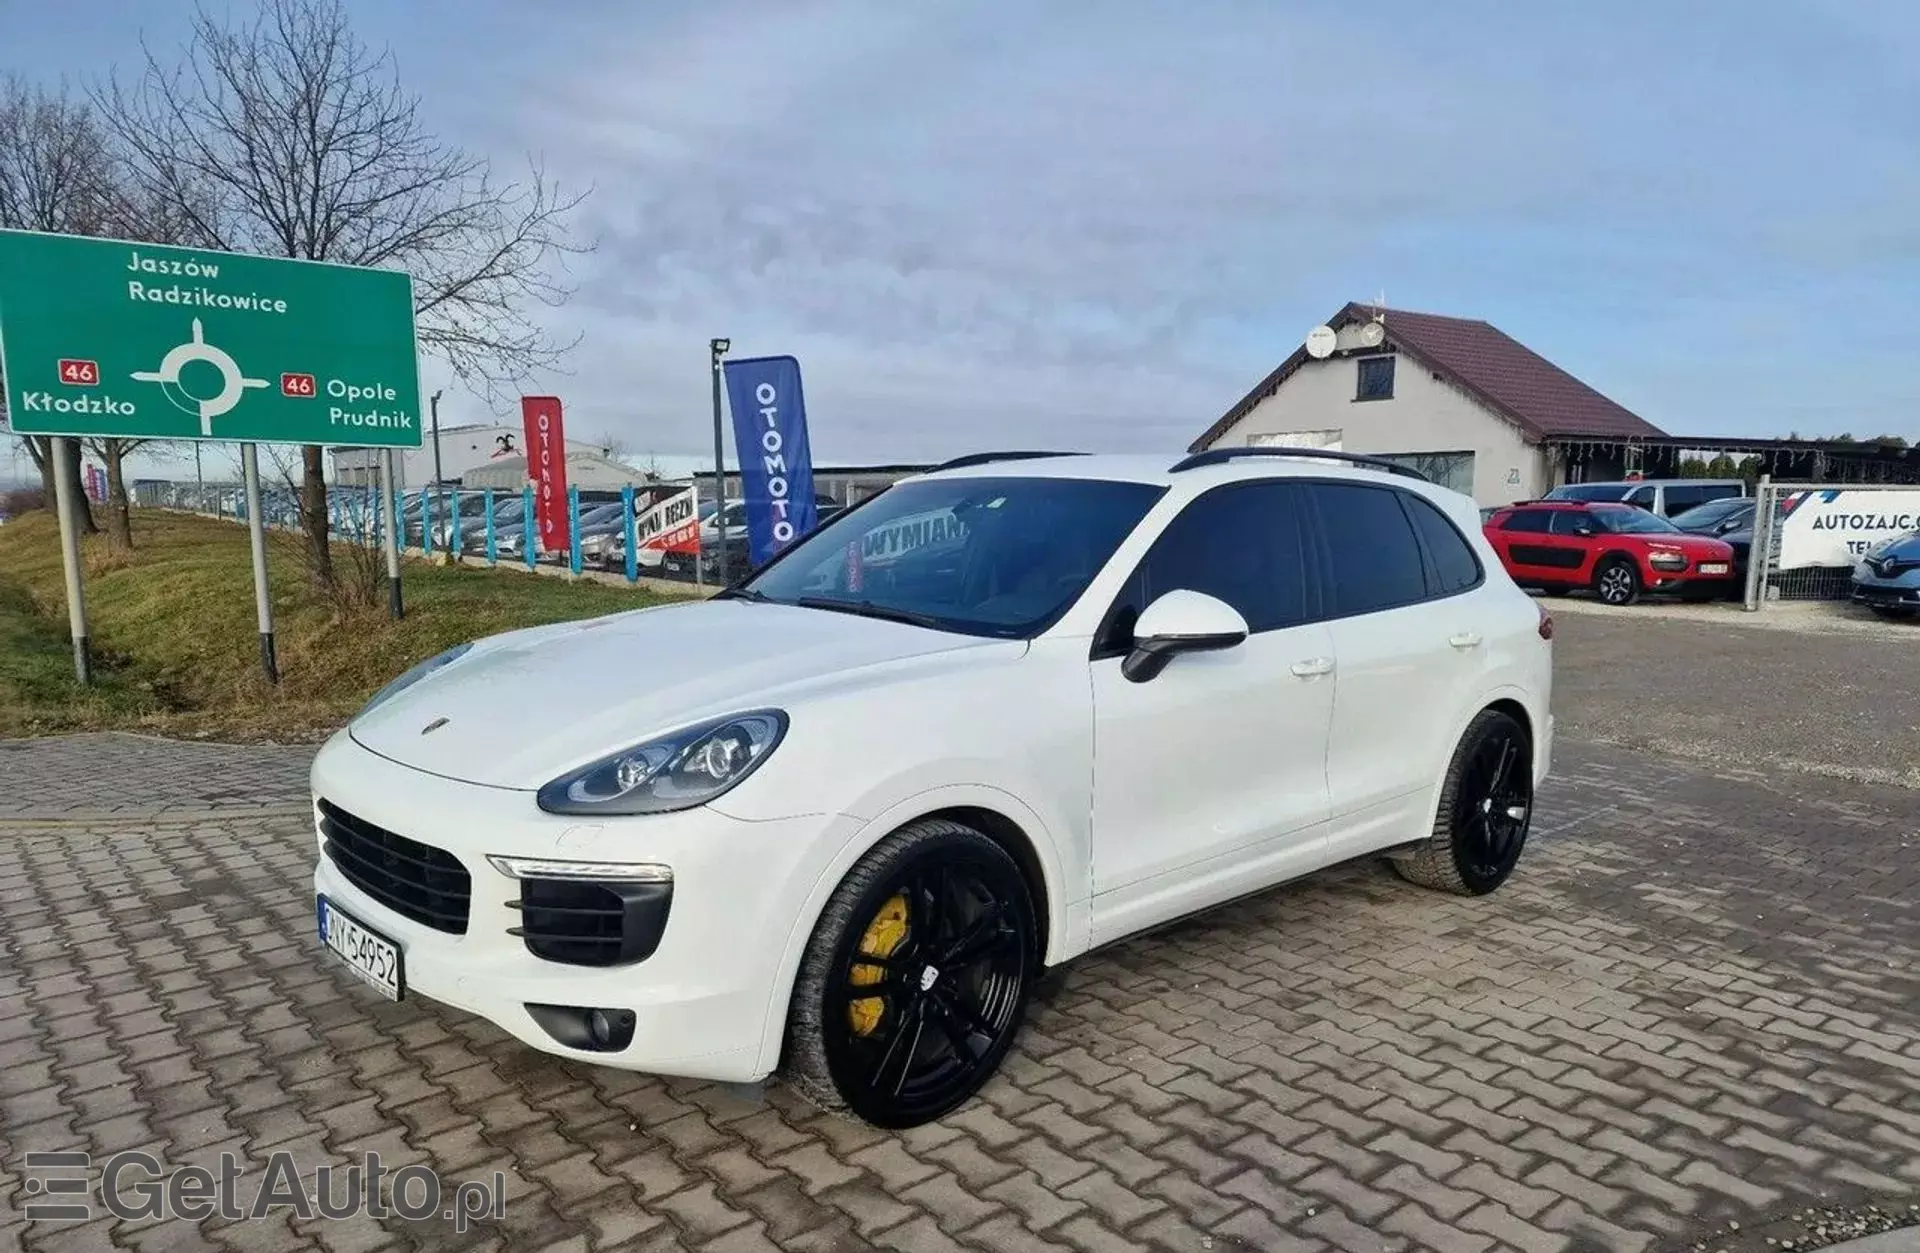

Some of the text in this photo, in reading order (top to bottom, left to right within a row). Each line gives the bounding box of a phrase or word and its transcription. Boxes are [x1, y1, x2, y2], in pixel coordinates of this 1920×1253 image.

[127, 252, 220, 278] Jaszów
[128, 280, 288, 313] Radzikowice
[64, 363, 93, 382] 46
[285, 376, 311, 395] 46
[22, 391, 136, 416] Kłodzko
[327, 379, 397, 402] Opole
[330, 407, 412, 429] Prudnik
[538, 414, 553, 534] OTOMOTO
[755, 382, 794, 542] OTOMOTO
[862, 512, 971, 558] WYMIAN
[351, 926, 396, 987] 54952
